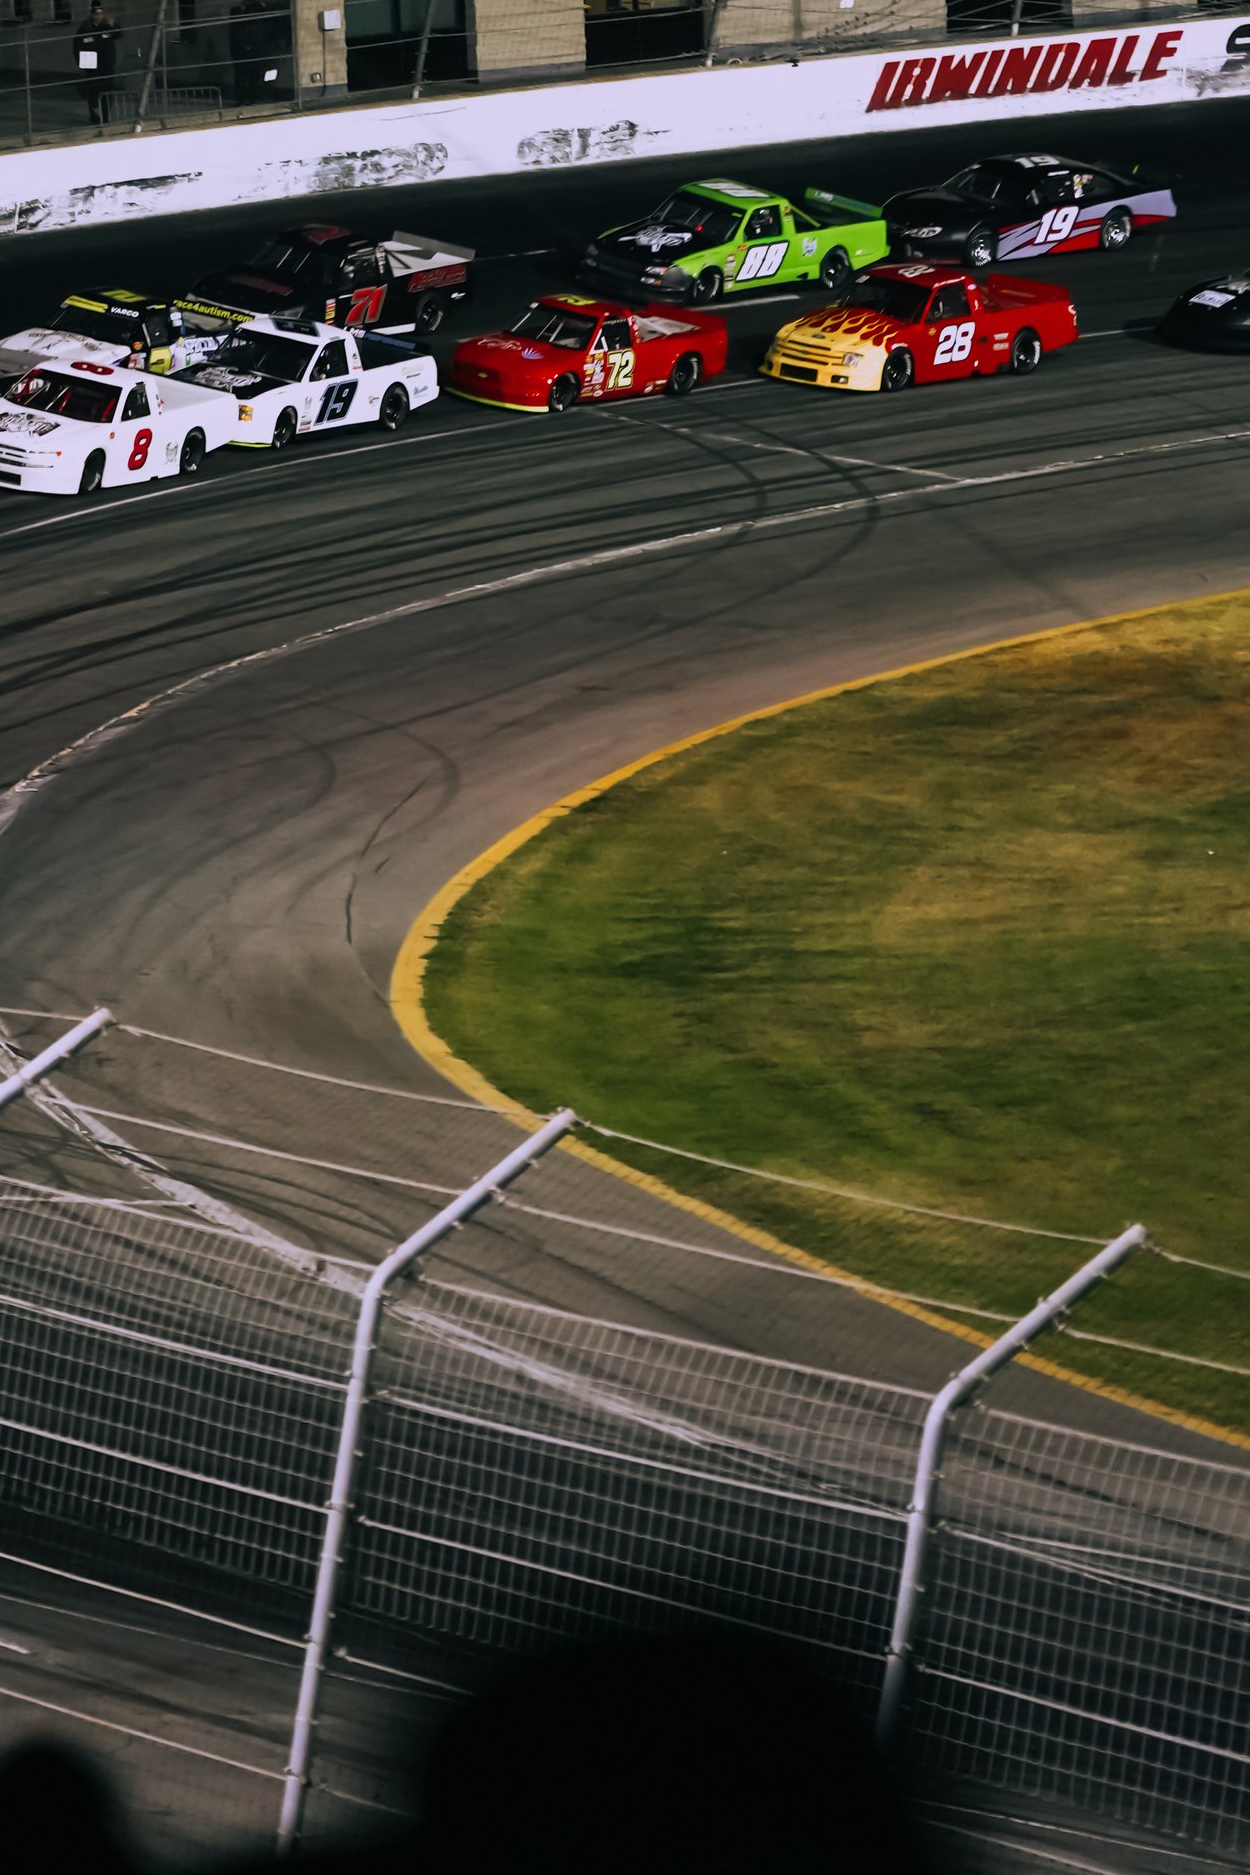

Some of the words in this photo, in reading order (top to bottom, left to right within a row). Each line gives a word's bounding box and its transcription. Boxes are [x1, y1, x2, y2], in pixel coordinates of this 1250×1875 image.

[866, 30, 1184, 112] IRWINDALE
[1034, 205, 1080, 245] 19
[111, 306, 140, 319] VARCO
[344, 283, 388, 328] 71
[933, 321, 976, 366] 28
[605, 348, 637, 391] 72
[314, 377, 359, 425] 19
[128, 428, 153, 471] 8
